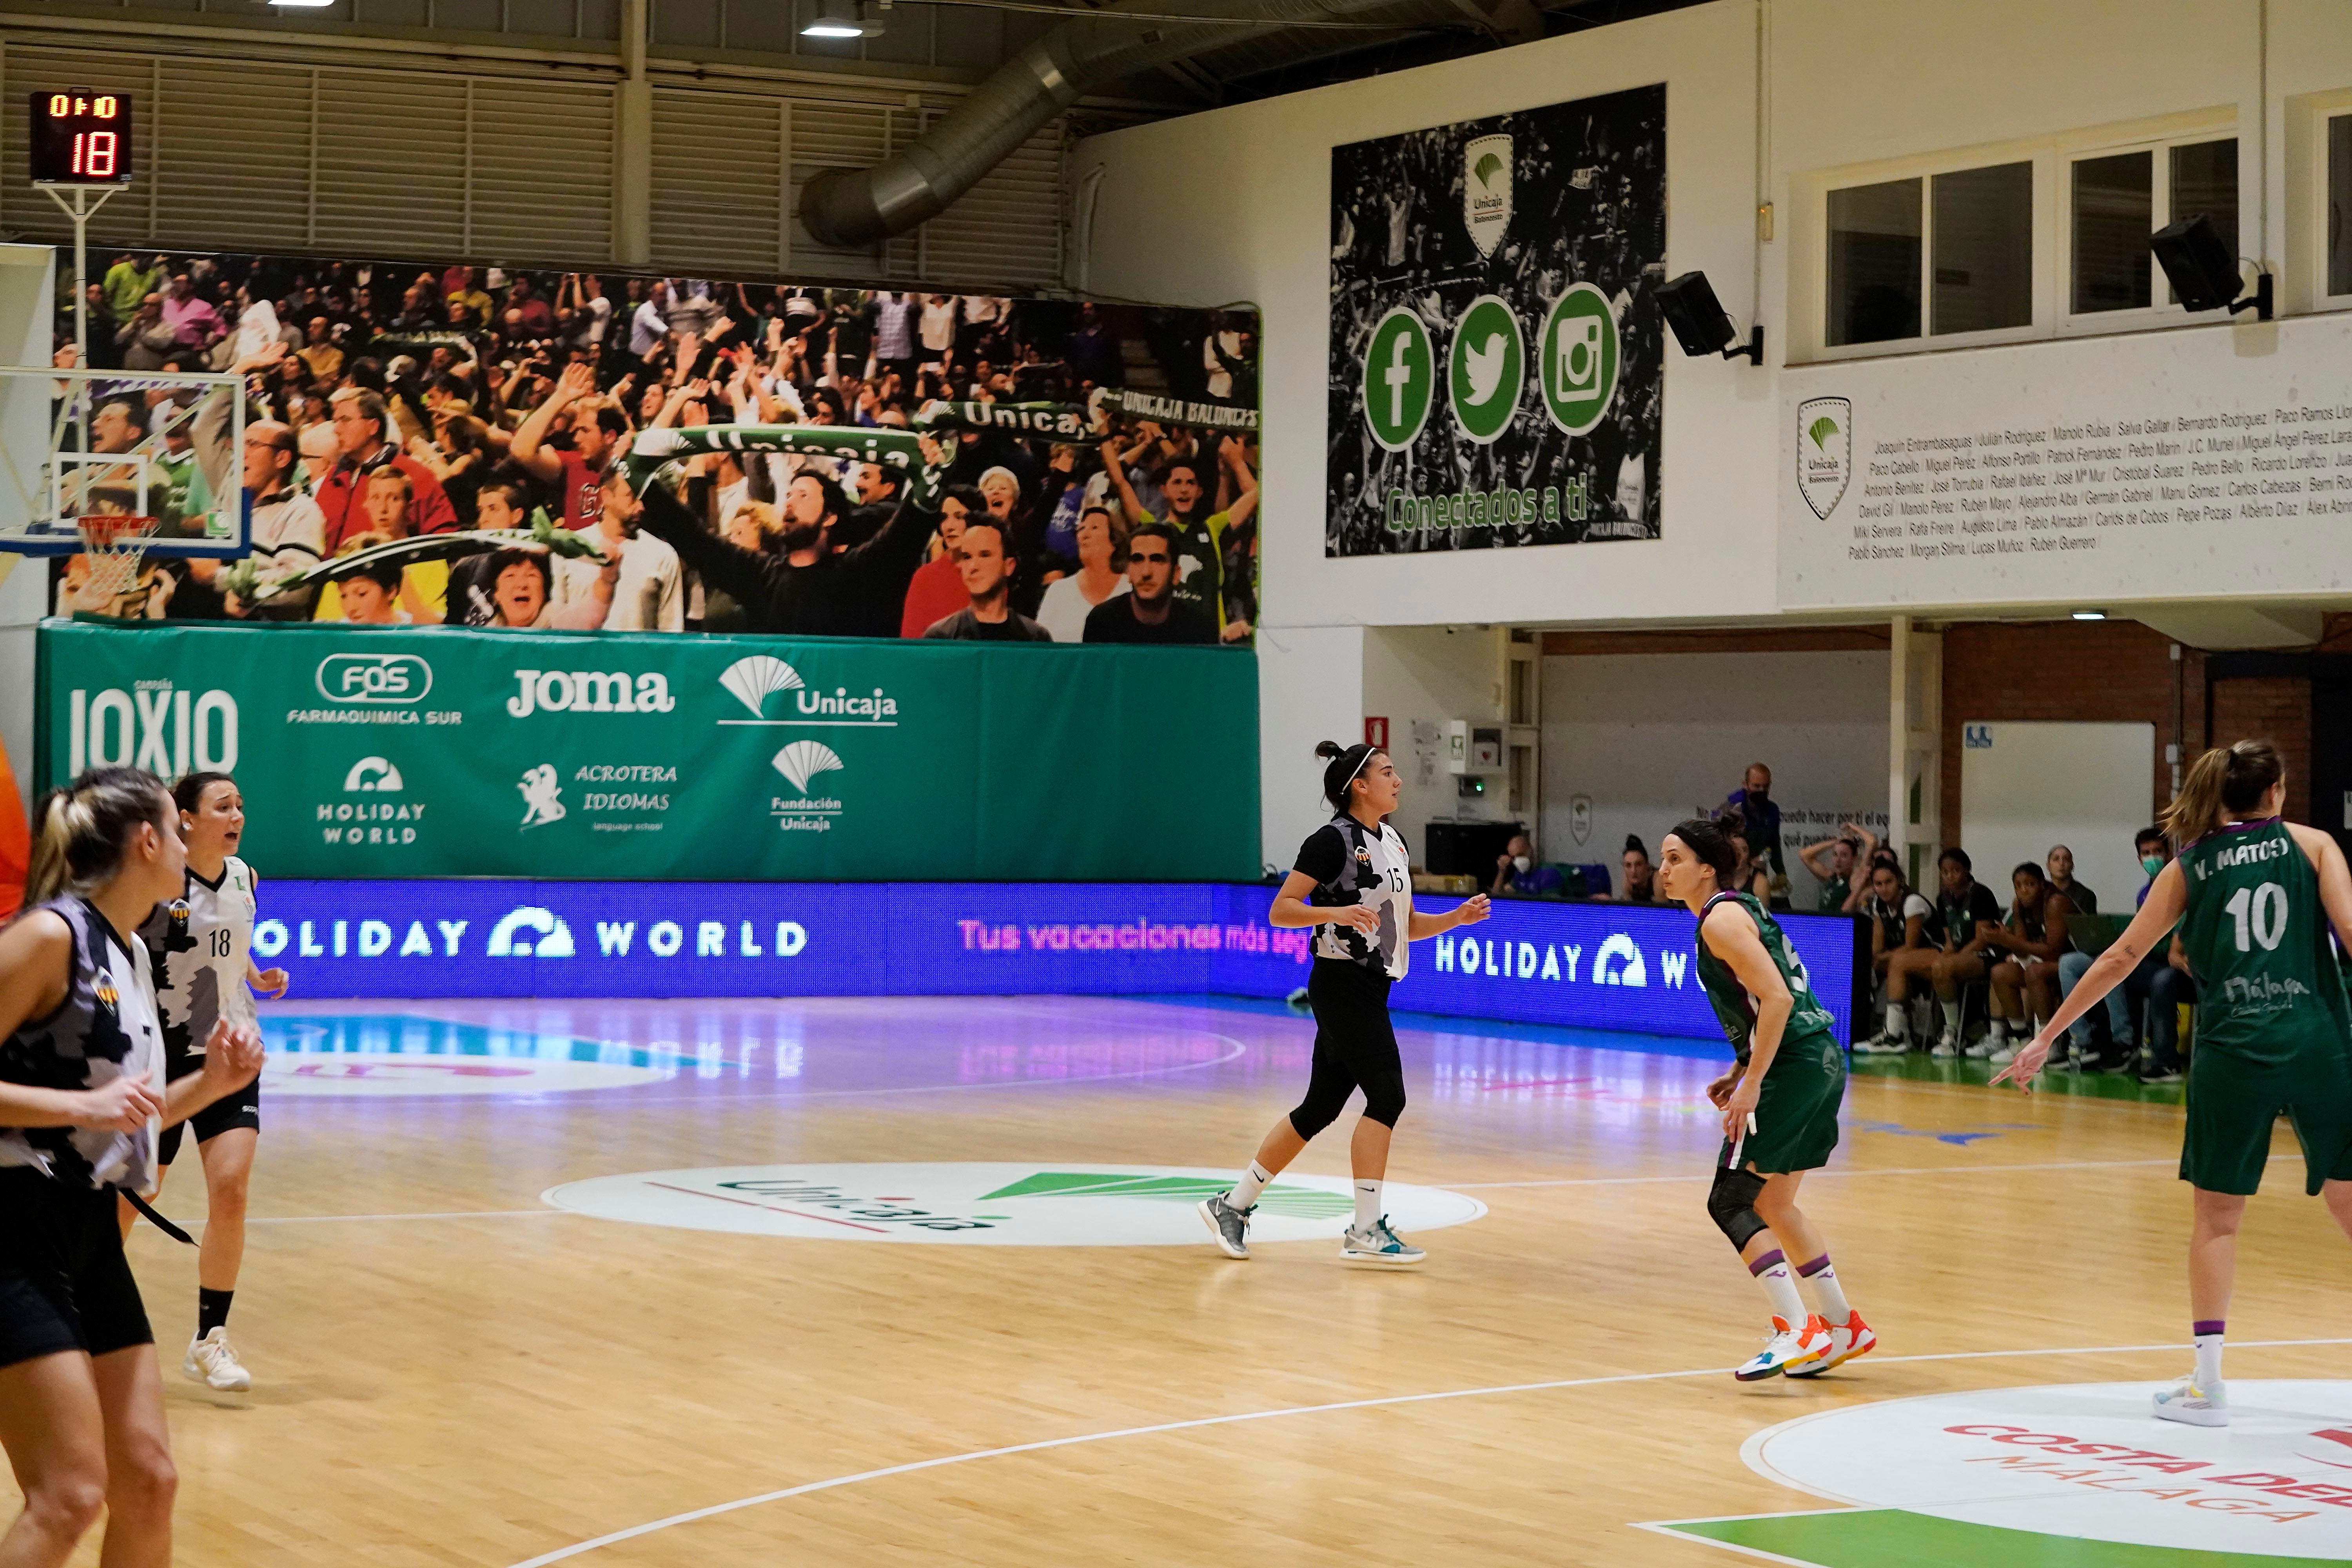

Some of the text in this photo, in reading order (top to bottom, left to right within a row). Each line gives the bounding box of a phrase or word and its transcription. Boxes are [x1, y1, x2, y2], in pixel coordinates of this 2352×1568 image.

[72, 131, 117, 176] 18
[1473, 192, 1503, 210] Unicaja
[1474, 214, 1503, 224] Baloncesto
[1122, 391, 1184, 421] UNICAJA
[2177, 415, 2218, 431] Bernardo
[2275, 408, 2299, 424] Paco
[2301, 407, 2334, 421] Ramos
[1808, 456, 1838, 472] Unicaja
[1869, 462, 1889, 476] Paco
[1891, 459, 1920, 475] Cabello
[1926, 457, 1951, 475] Miguel
[2128, 441, 2155, 458] Pedro
[2242, 433, 2272, 453] Miguel
[1865, 483, 1893, 497] Antonio
[2192, 461, 2220, 476] Pedro
[2251, 456, 2288, 472] Ricardo
[2227, 480, 2258, 496] Carlos
[2260, 478, 2301, 494] Cabezas
[1386, 479, 1538, 534] Conectados
[1542, 486, 1561, 524] a
[1565, 472, 1588, 523] ti
[1961, 520, 1995, 536] Augusto
[2024, 515, 2049, 530] Pablo
[2095, 511, 2124, 527] Carlos
[2239, 503, 2274, 519] Alberto
[1848, 545, 1871, 560] Pablo
[1971, 541, 1996, 555] Lucas
[286, 709, 463, 725] FARMAQUIMICA SUR
[796, 687, 899, 722] Unicaja
[574, 765, 678, 783] ACROTERA
[316, 803, 426, 822] HOLIDAY
[583, 792, 670, 811] IDIOMAS
[771, 797, 842, 810] Fundación
[323, 827, 417, 845] WORLD
[780, 815, 831, 833] Unicaja
[1386, 867, 1404, 893] 15
[2194, 859, 2214, 881] V.
[2225, 882, 2289, 952] 10
[208, 928, 231, 958] 18
[252, 918, 809, 958] OLIDAY WORLD
[957, 919, 1020, 950] Tus
[1026, 915, 1221, 951] vacaciones
[1434, 934, 1583, 984] HOLIDAY
[715, 1179, 1013, 1231] Unicaja
[1942, 1423, 2217, 1475] COSTA
